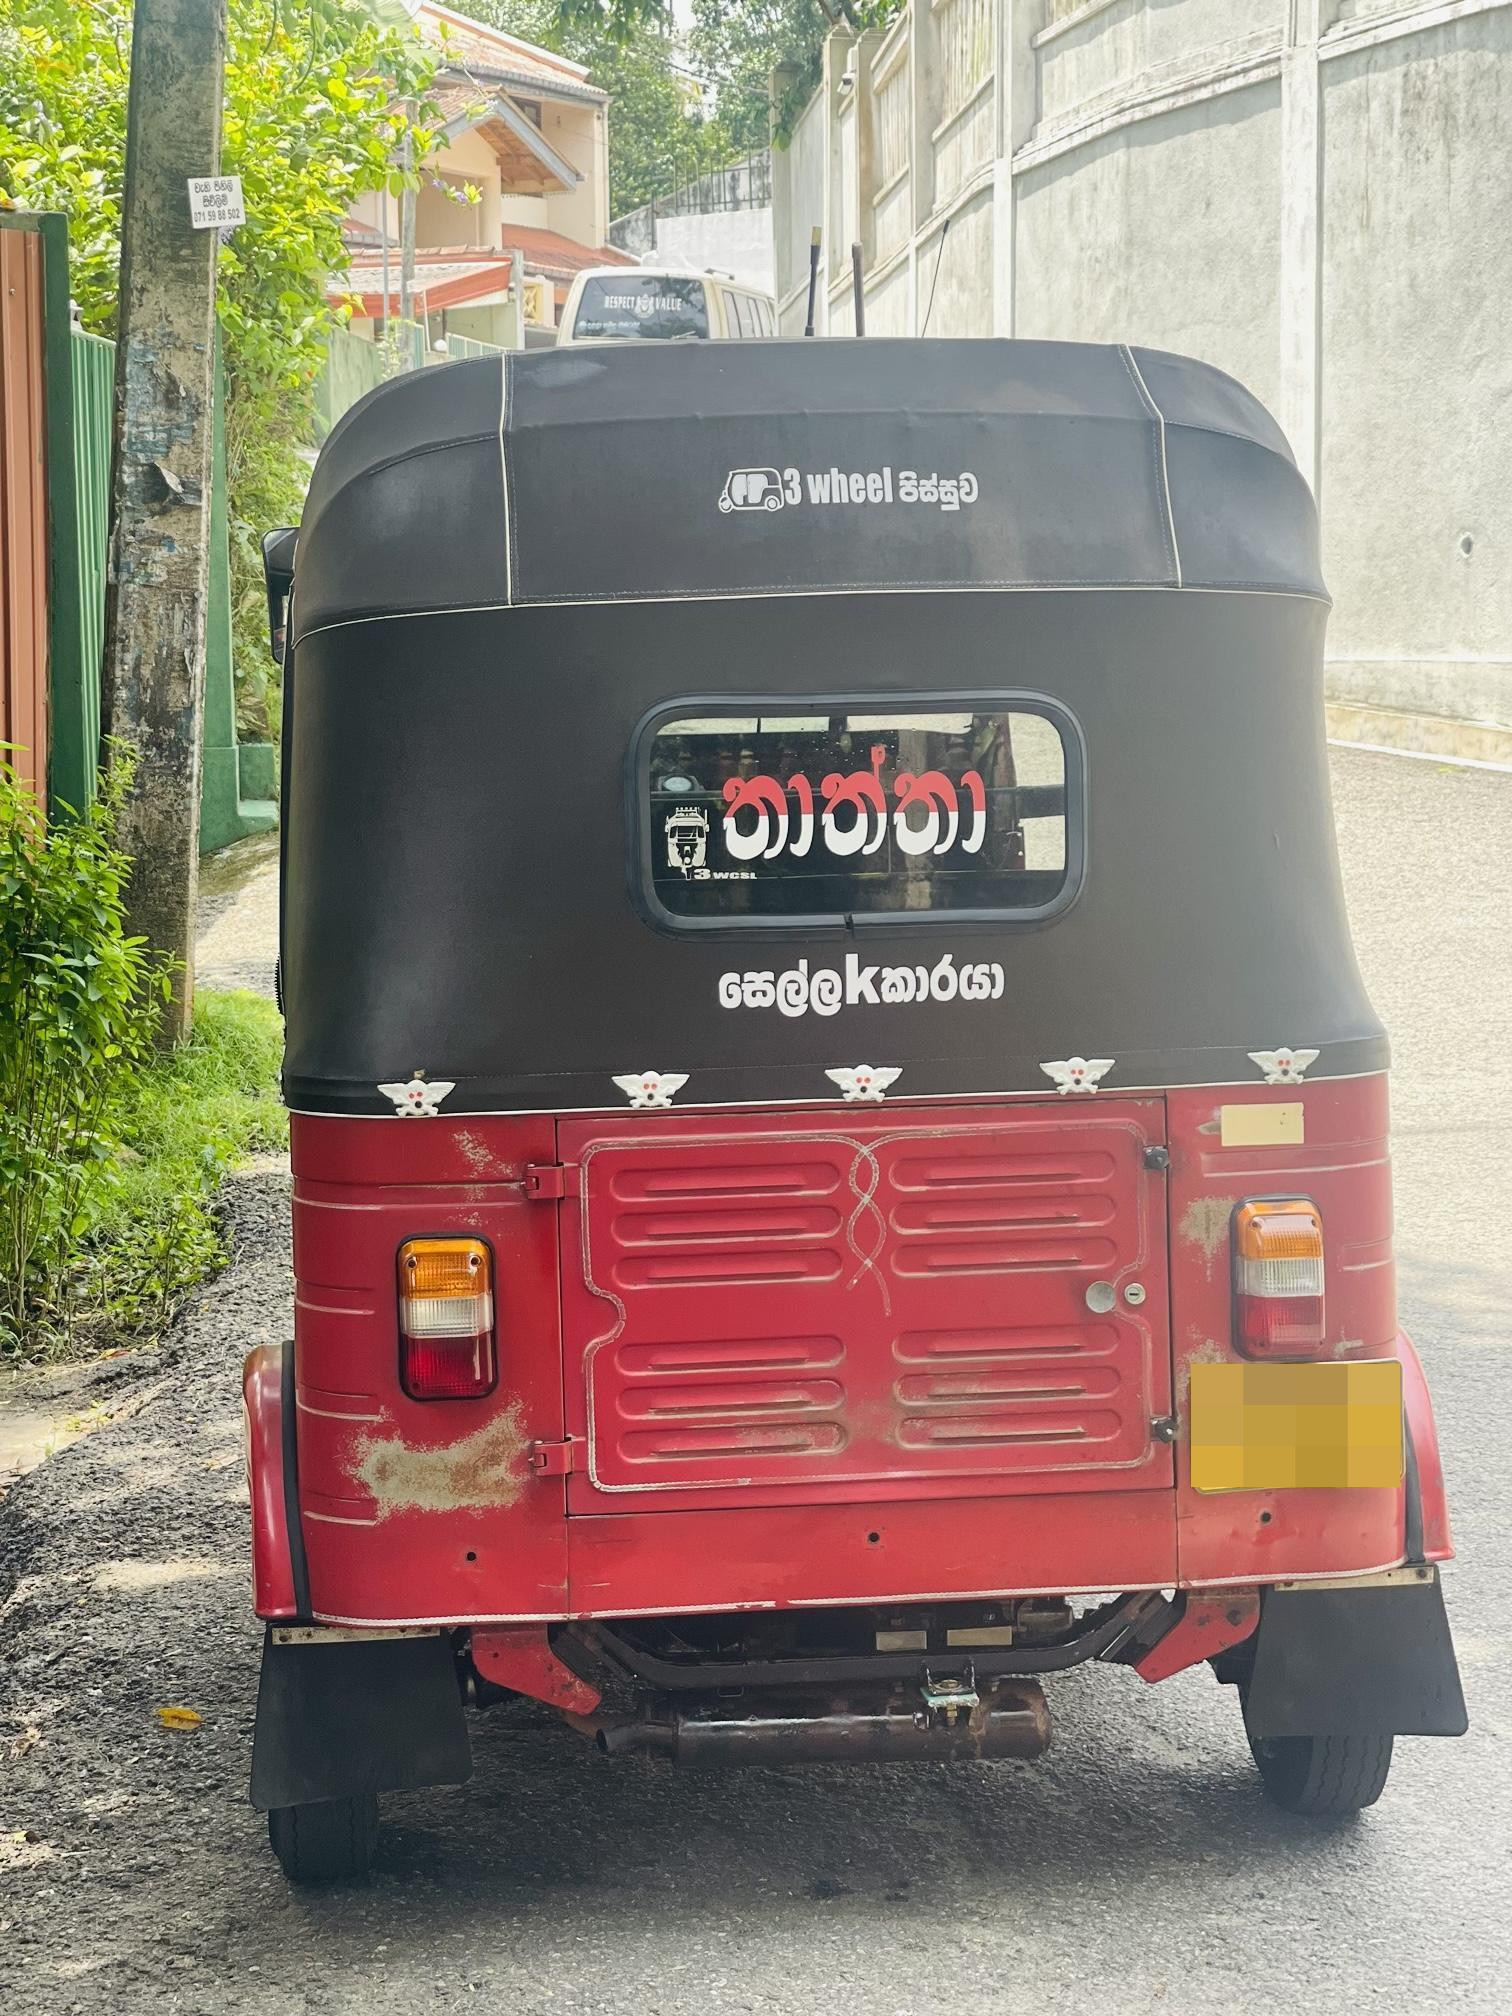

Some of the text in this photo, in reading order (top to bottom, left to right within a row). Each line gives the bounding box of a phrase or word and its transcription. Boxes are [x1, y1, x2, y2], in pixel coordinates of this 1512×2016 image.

[194, 211, 206, 222] 071
[207, 210, 216, 221] 59
[228, 208, 240, 219] 502
[604, 296, 682, 310] RESPECT VALUE
[784, 467, 979, 511] 3 wheel පිස්සුව
[722, 744, 986, 861] තාත්තා
